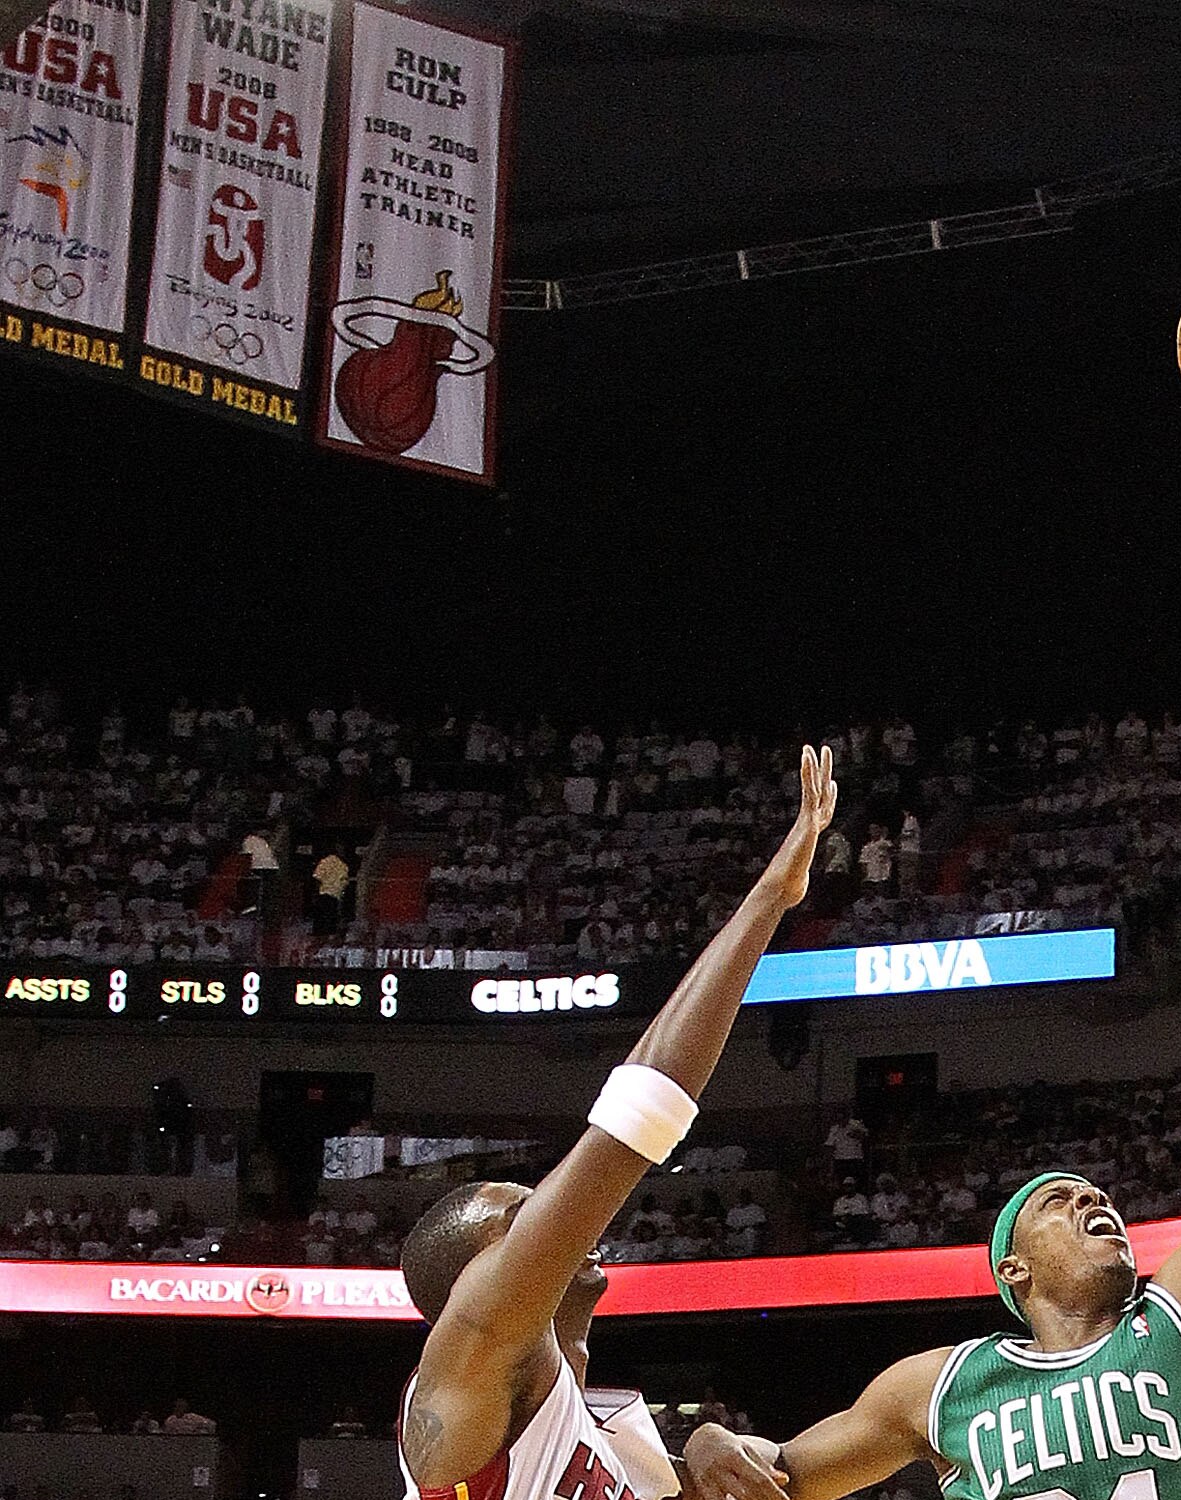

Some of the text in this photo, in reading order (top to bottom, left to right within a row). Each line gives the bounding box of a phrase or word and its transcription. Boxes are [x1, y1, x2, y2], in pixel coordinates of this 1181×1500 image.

[3, 31, 122, 100] USA
[203, 12, 299, 72] WADE
[386, 70, 468, 110] CULP
[395, 47, 462, 86] RON
[187, 82, 303, 160] USA
[391, 148, 454, 179] HEAD
[361, 167, 477, 214] ATHLETIC
[360, 192, 475, 239] TRAINER
[31, 322, 124, 369] MEDAL
[140, 354, 298, 425] GOLD MEDAL
[855, 939, 992, 995] BBVA
[5, 969, 619, 1013] ASSTS 0 STLS 0 BLKS 0 CELTICS
[109, 990, 397, 1018] 0 0 0
[110, 1277, 414, 1307] BACARDI PLEAS
